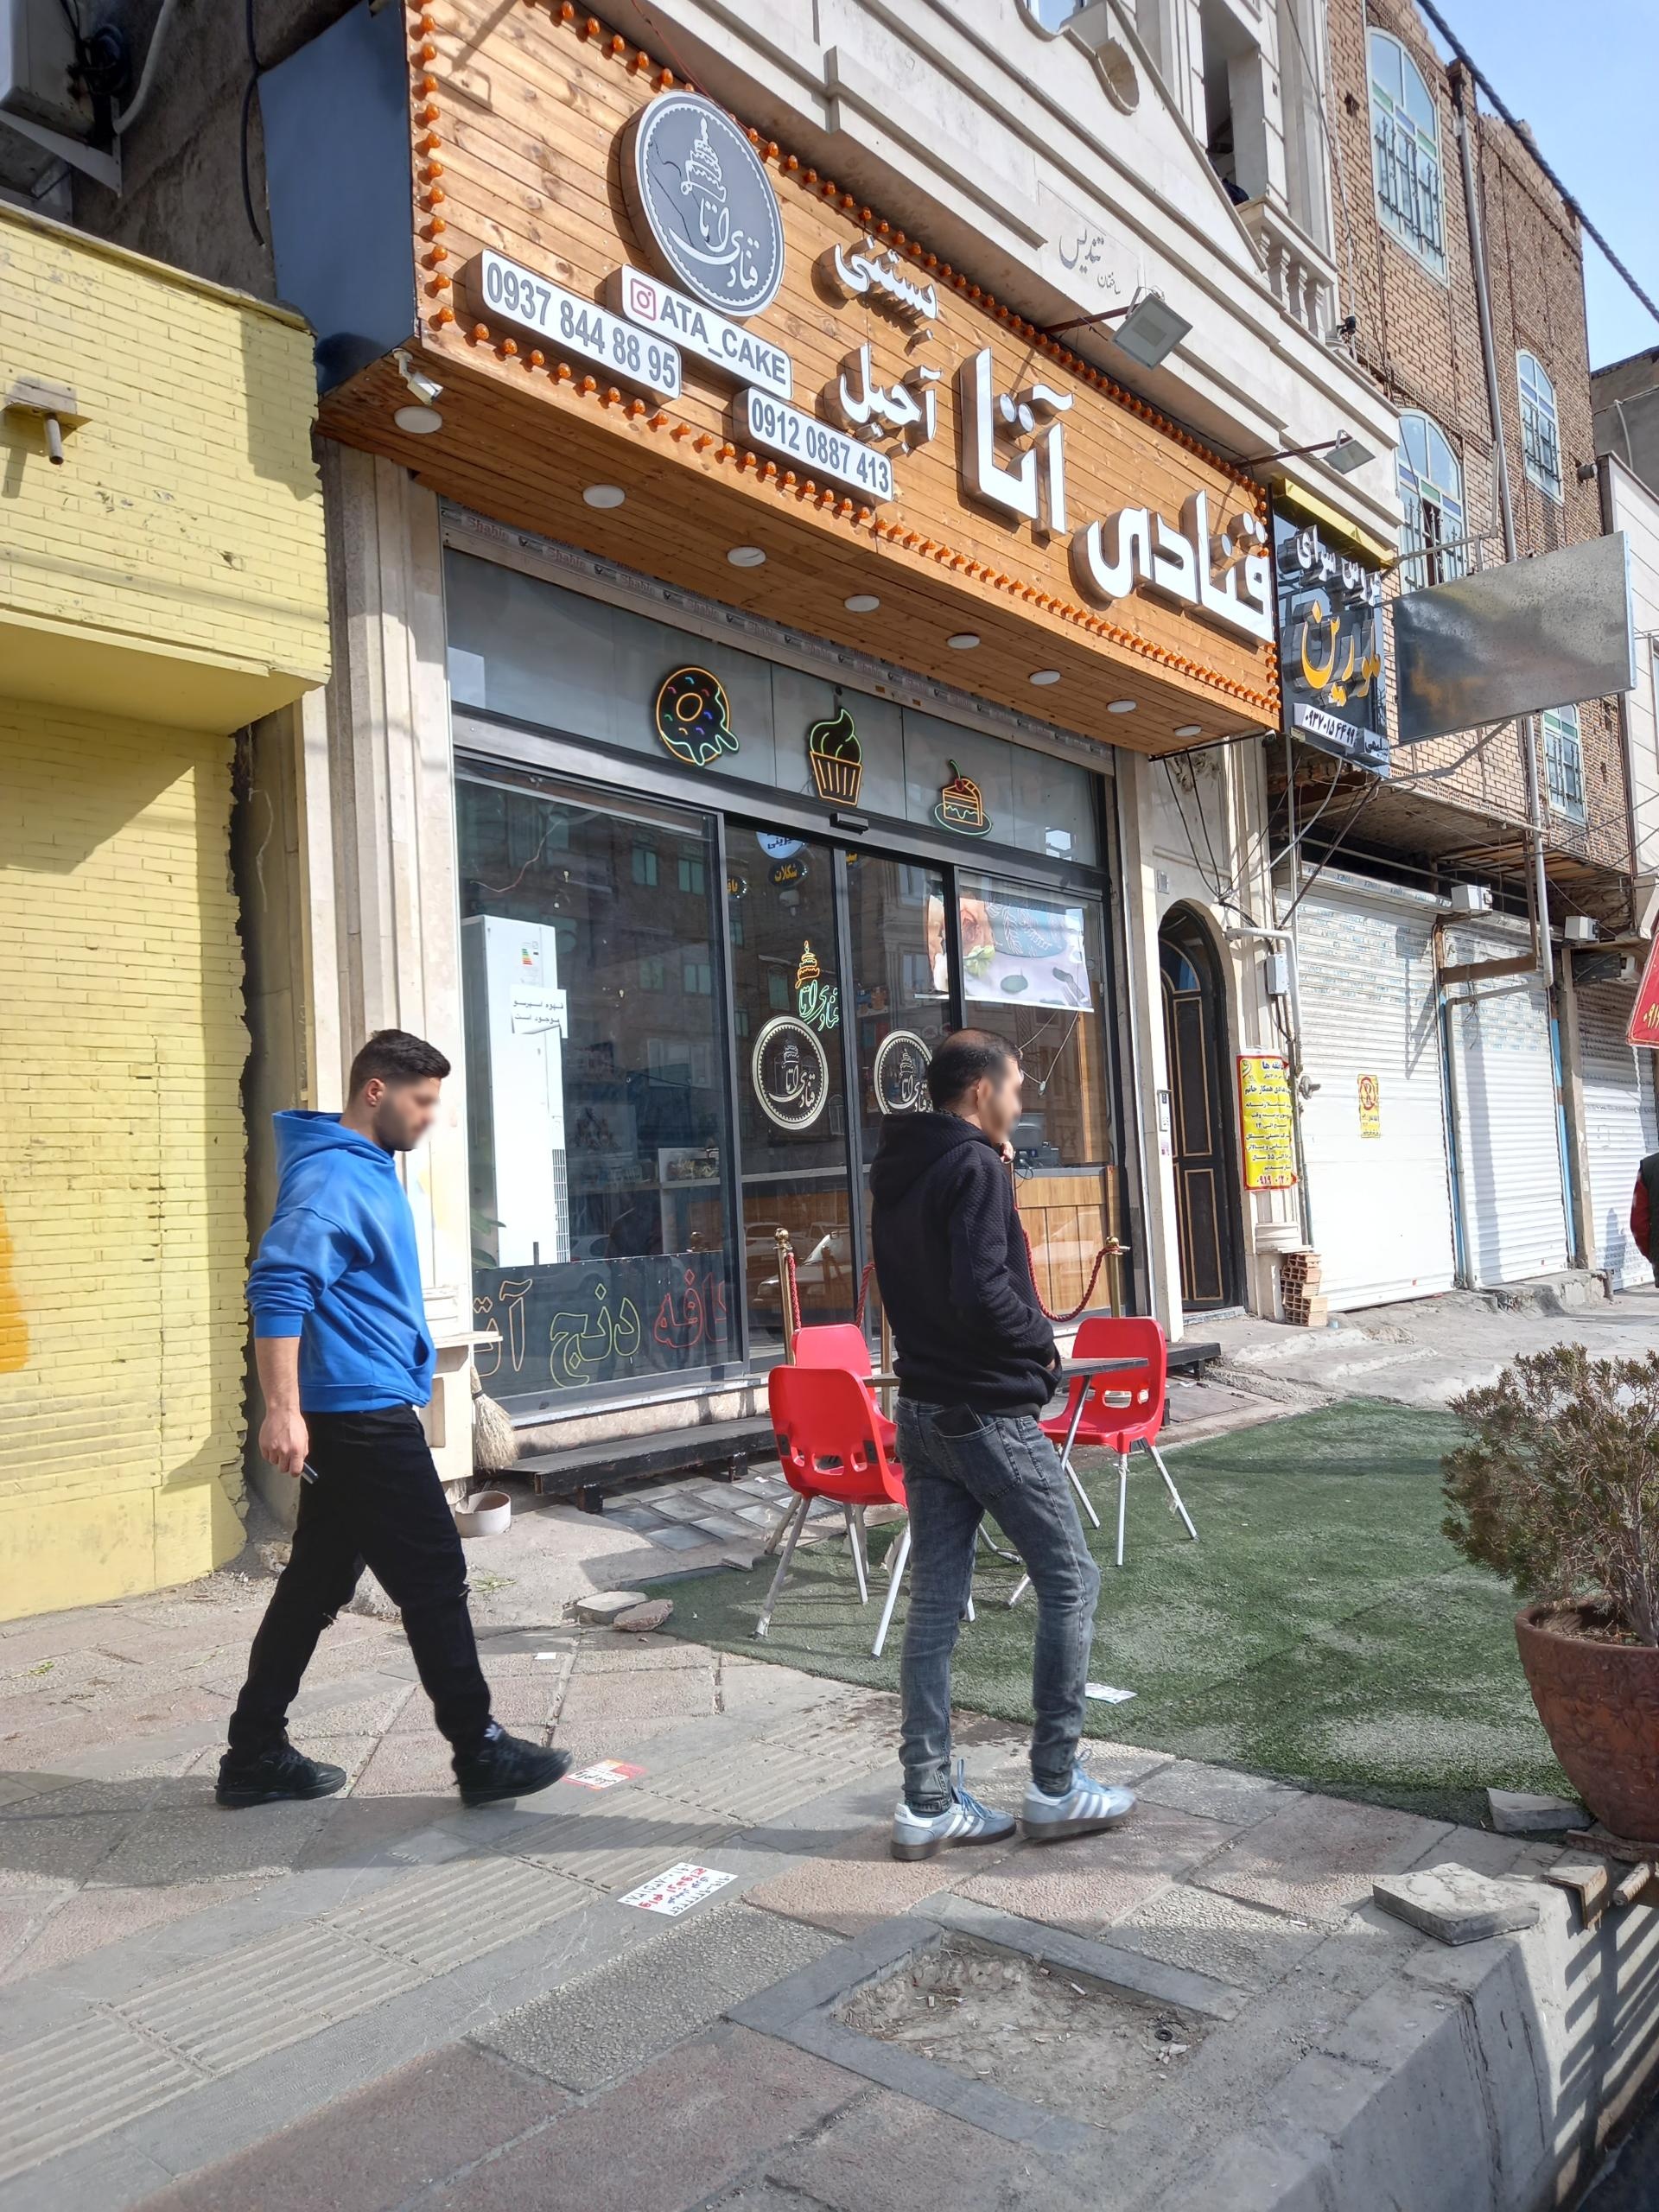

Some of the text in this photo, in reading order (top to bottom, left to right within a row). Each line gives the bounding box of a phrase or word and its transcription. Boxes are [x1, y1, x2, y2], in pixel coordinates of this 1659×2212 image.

[486, 261, 677, 391] 0937 844 88 95
[834, 235, 940, 340] بستنی
[659, 300, 788, 385] ATA_CAKE
[751, 397, 890, 493] 0912 0887 413
[838, 342, 943, 452] آجیل
[973, 347, 1273, 646] قنادی آتا
[1296, 524, 1337, 582] سرای
[473, 1279, 533, 1377] آت
[665, 1867, 708, 1893] ازدواج
